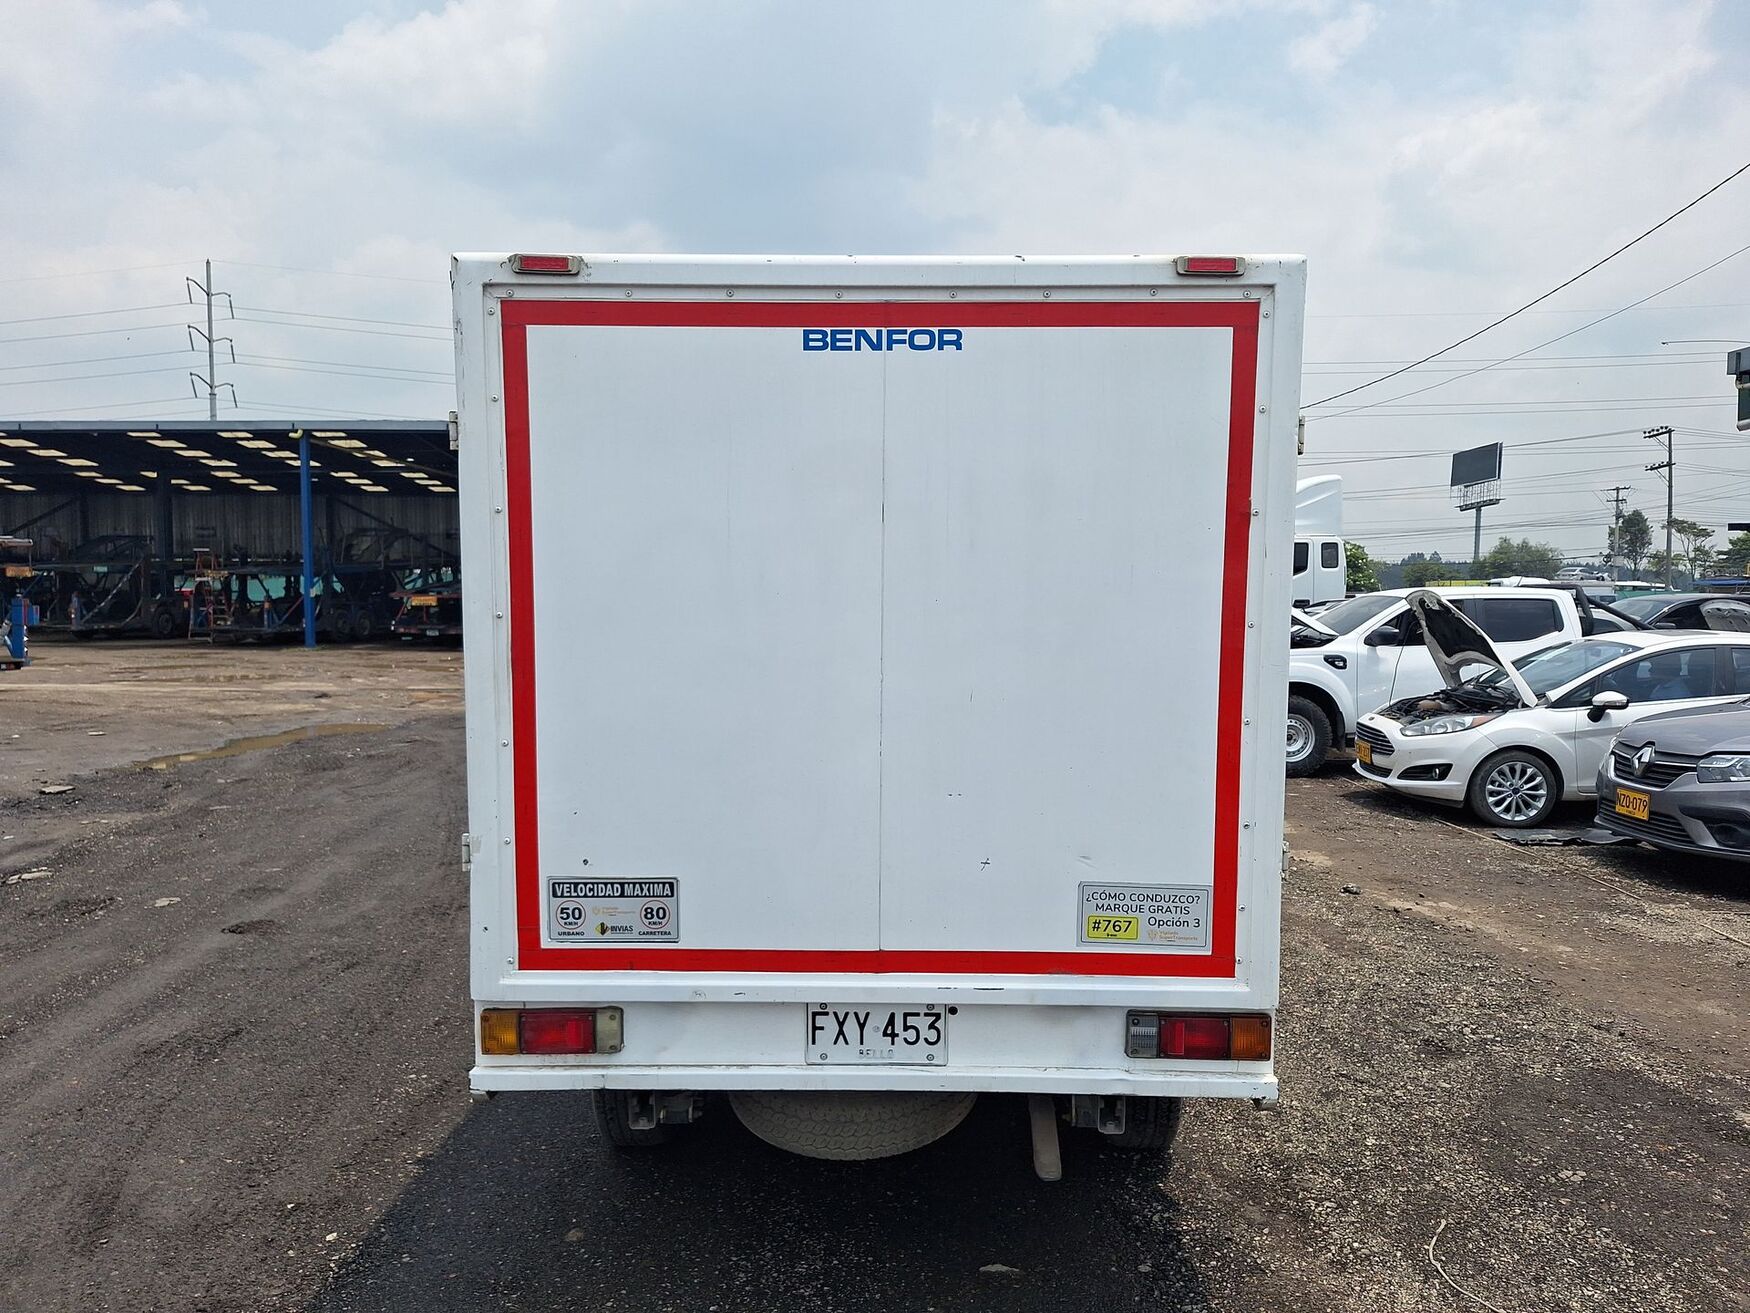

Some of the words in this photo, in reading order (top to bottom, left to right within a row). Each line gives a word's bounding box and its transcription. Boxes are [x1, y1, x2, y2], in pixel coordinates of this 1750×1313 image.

[803, 329, 963, 351] BENFOR
[555, 883, 621, 896] VELOCIDAD
[624, 883, 672, 896] MAXIMA
[1086, 890, 1126, 902] ¿CÓMO
[1129, 893, 1201, 904] CONDUZCO?
[559, 907, 582, 920] 50
[644, 906, 667, 920] 80
[1095, 903, 1145, 914] MARQUE
[1148, 905, 1190, 915] GRATIS
[1092, 919, 1132, 933] #767
[1148, 916, 1189, 928] Opción
[1193, 918, 1201, 928] 3
[811, 1010, 870, 1045] FXY
[882, 1011, 942, 1046] 453
